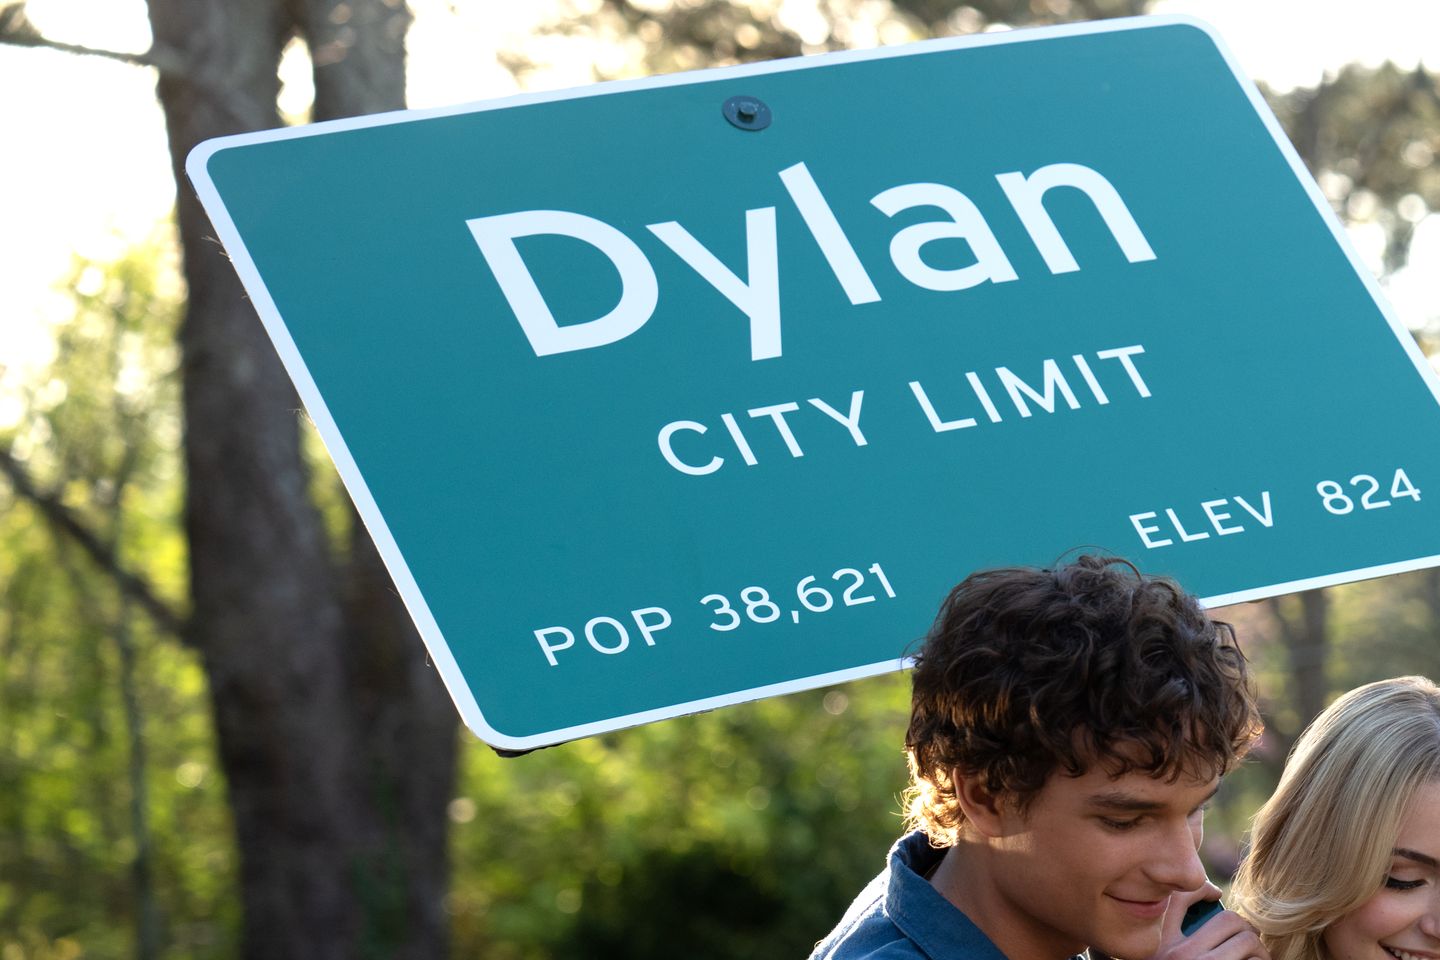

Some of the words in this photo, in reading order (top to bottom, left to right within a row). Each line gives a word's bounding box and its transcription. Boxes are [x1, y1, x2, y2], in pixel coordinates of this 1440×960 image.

[465, 161, 1157, 361] Dylan
[657, 390, 868, 476] CITY
[908, 344, 1152, 433] LIMIT
[1129, 491, 1274, 549] ELEV
[1316, 468, 1421, 515] 824
[533, 606, 672, 666] POP
[700, 562, 896, 632] 38,621
